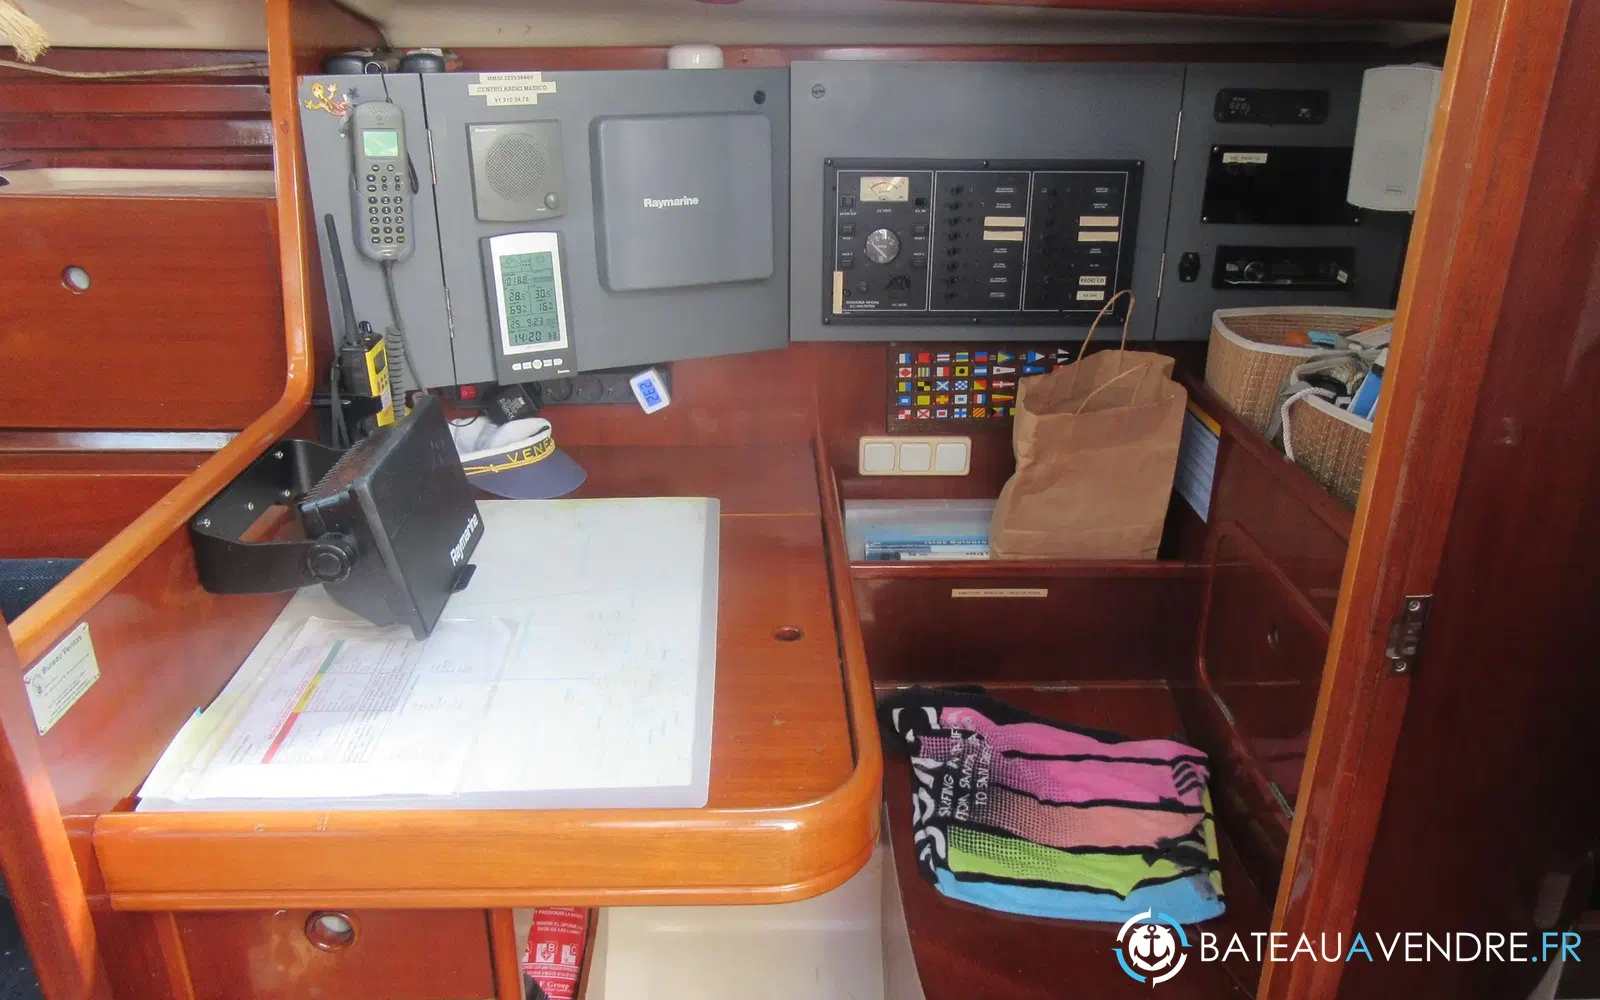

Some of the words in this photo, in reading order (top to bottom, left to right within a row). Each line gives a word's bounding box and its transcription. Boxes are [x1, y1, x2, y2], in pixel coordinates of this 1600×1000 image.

[643, 195, 699, 209] Raymarine
[450, 513, 479, 567] Raymarine
[939, 773, 954, 817] SURFING
[548, 943, 555, 952] B
